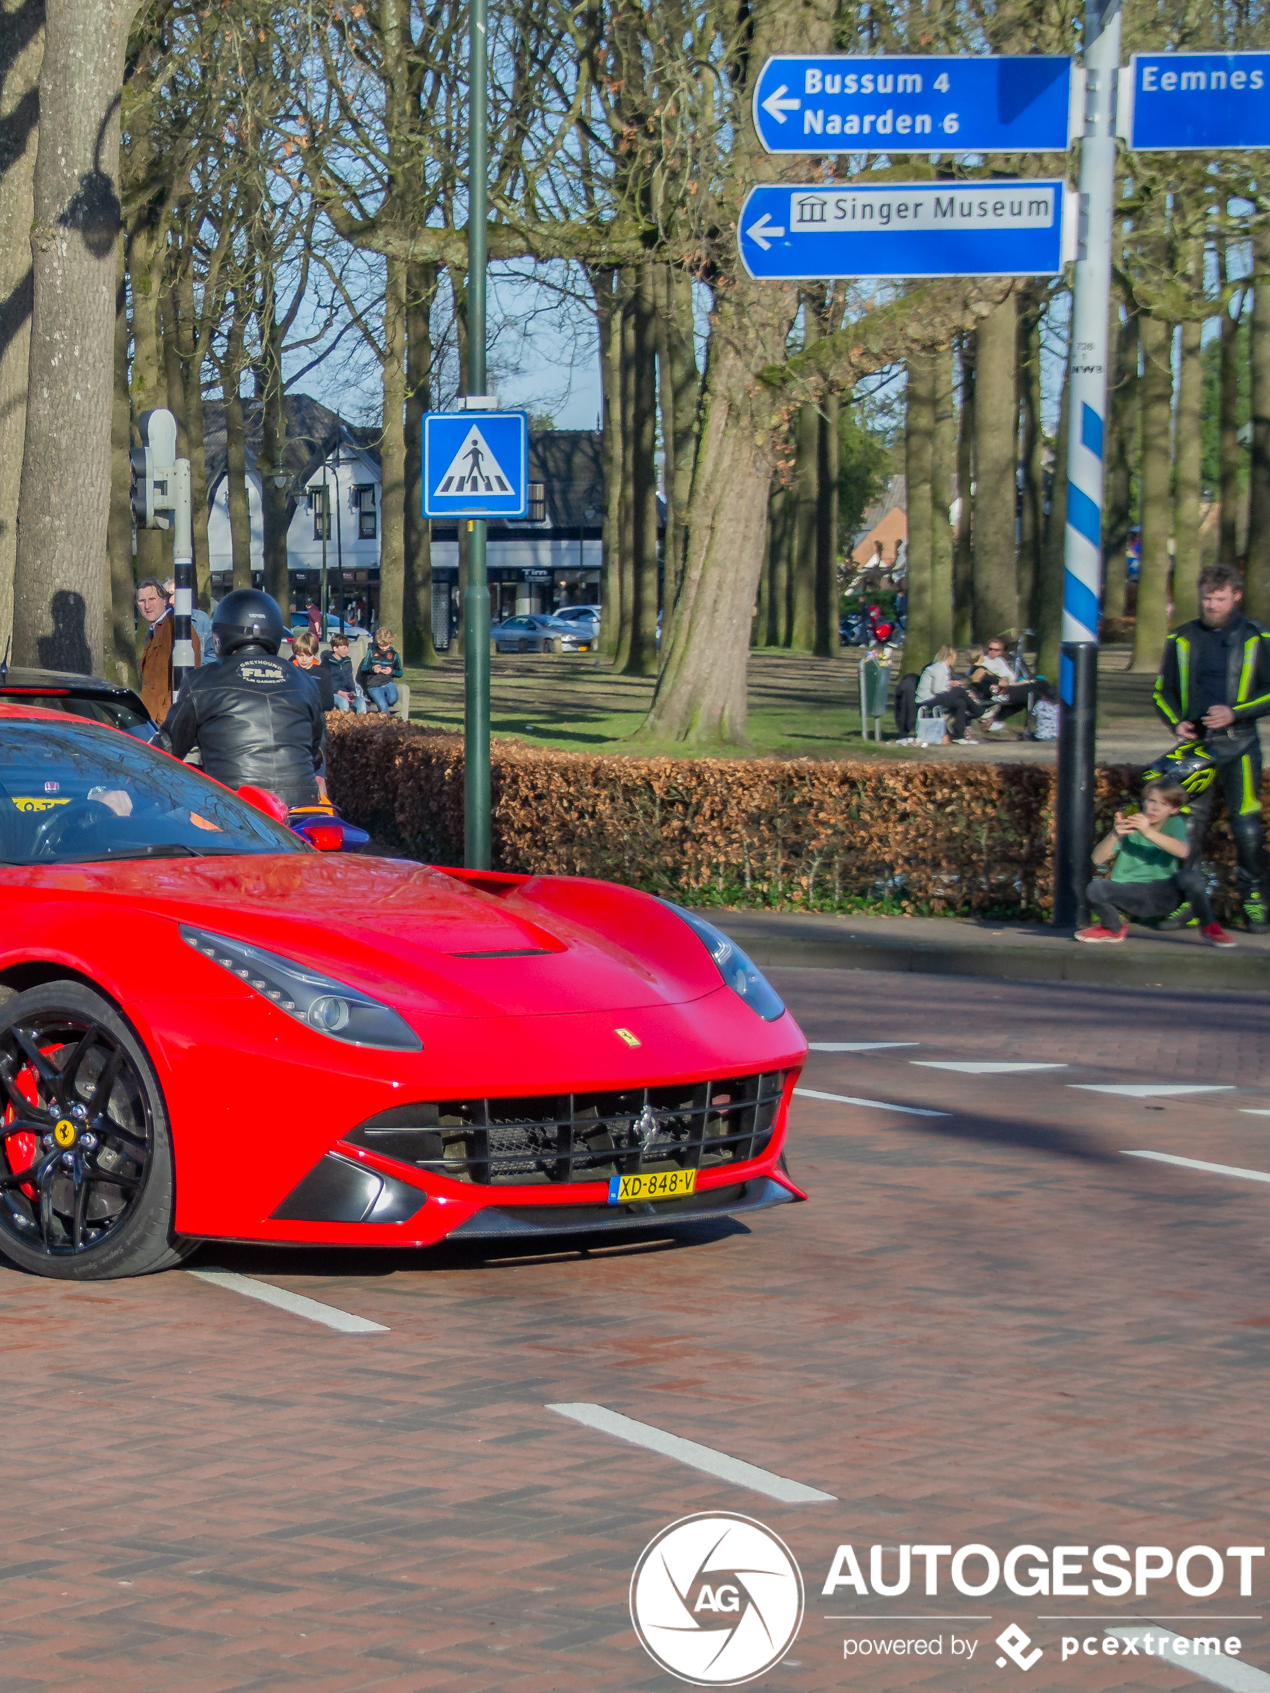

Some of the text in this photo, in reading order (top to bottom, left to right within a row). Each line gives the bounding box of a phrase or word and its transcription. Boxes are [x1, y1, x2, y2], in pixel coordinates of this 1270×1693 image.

[805, 68, 950, 95] Bussum 4
[1142, 65, 1264, 92] Eemnes
[804, 109, 960, 135] Naarden 6
[833, 195, 1050, 226] Singer Museum
[240, 660, 283, 670] GREYHOUND
[241, 668, 284, 678] FLM
[620, 1171, 694, 1198] XD-848-V
